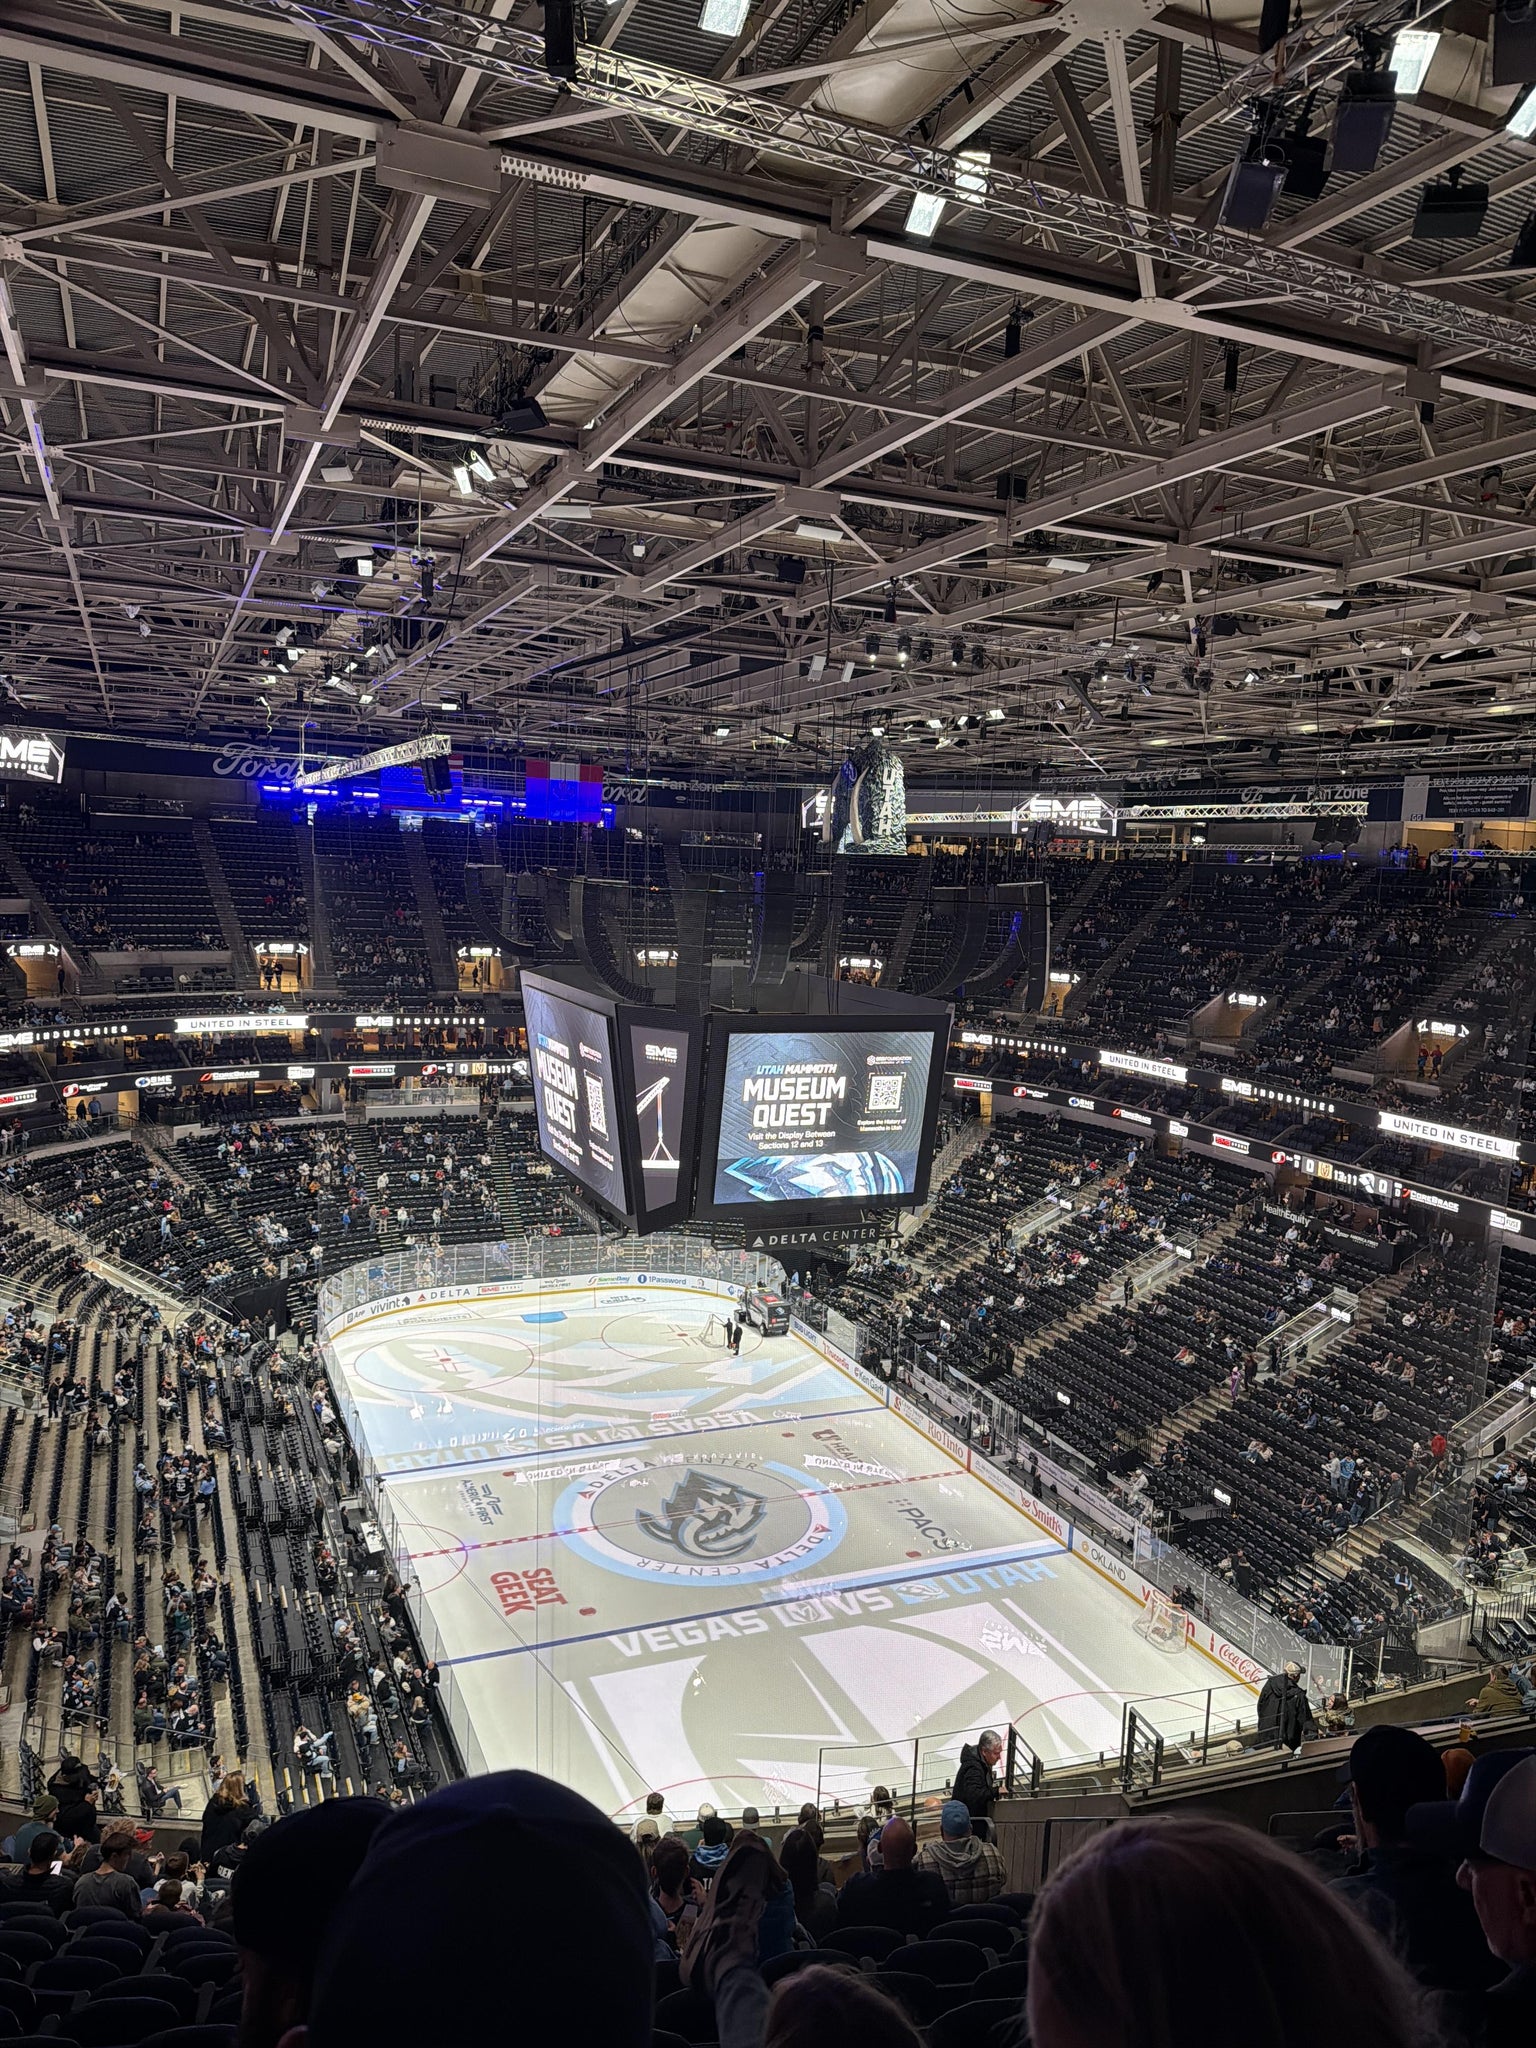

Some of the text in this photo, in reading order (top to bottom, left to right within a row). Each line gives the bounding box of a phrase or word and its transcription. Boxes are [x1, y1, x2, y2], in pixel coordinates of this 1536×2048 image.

[1334, 784, 1369, 800] Zone
[190, 1018, 292, 1029] UNITED IN STEEL
[355, 1016, 485, 1027] SME INDUSTRIES
[0, 1025, 128, 1047] SME INDUSTRIES
[962, 1032, 1067, 1054] SME INDUSTRIES
[645, 1044, 678, 1059] SME
[459, 1064, 469, 1074] 0
[488, 1065, 511, 1074] 13:11
[536, 1048, 578, 1100] MUSEUM
[757, 1063, 837, 1075] UTAH MAMMOTH
[1110, 1055, 1177, 1077] UNITED IN STEEL
[743, 1076, 846, 1102] MUSEUM
[1222, 1078, 1335, 1113] SME INDUSTRIES
[544, 1085, 576, 1134] QUEST
[753, 1102, 832, 1128] QUEST
[748, 1130, 836, 1142] Visit the Display Between
[758, 1140, 823, 1150] Sections 12 and 13
[1394, 1118, 1501, 1152] UNITED IN STEEL
[1306, 1159, 1314, 1172] 0
[1333, 1169, 1357, 1186] 13:11
[1378, 1178, 1387, 1193] 0
[1409, 1190, 1459, 1210] COREBRACE
[1262, 1202, 1312, 1228] HealthEquity
[769, 1229, 876, 1246] DELTA CENTER
[649, 1275, 687, 1285] 1Password
[430, 1288, 471, 1299] DELTA
[386, 1446, 491, 1472] UTAH
[176, 1482, 186, 1492] 92
[591, 1461, 657, 1490] DELTA
[460, 1479, 480, 1509] AMERICA
[474, 1505, 494, 1526] FIRST
[1031, 1499, 1063, 1537] Smith's
[755, 1534, 823, 1570] DELTA
[1091, 1548, 1126, 1581] OKLAND
[636, 1557, 741, 1577] CENTER
[521, 1567, 569, 1605] SEAT
[945, 1561, 1058, 1600] UTAH
[490, 1571, 536, 1617] GEEK
[607, 1609, 770, 1659] VEGAS
